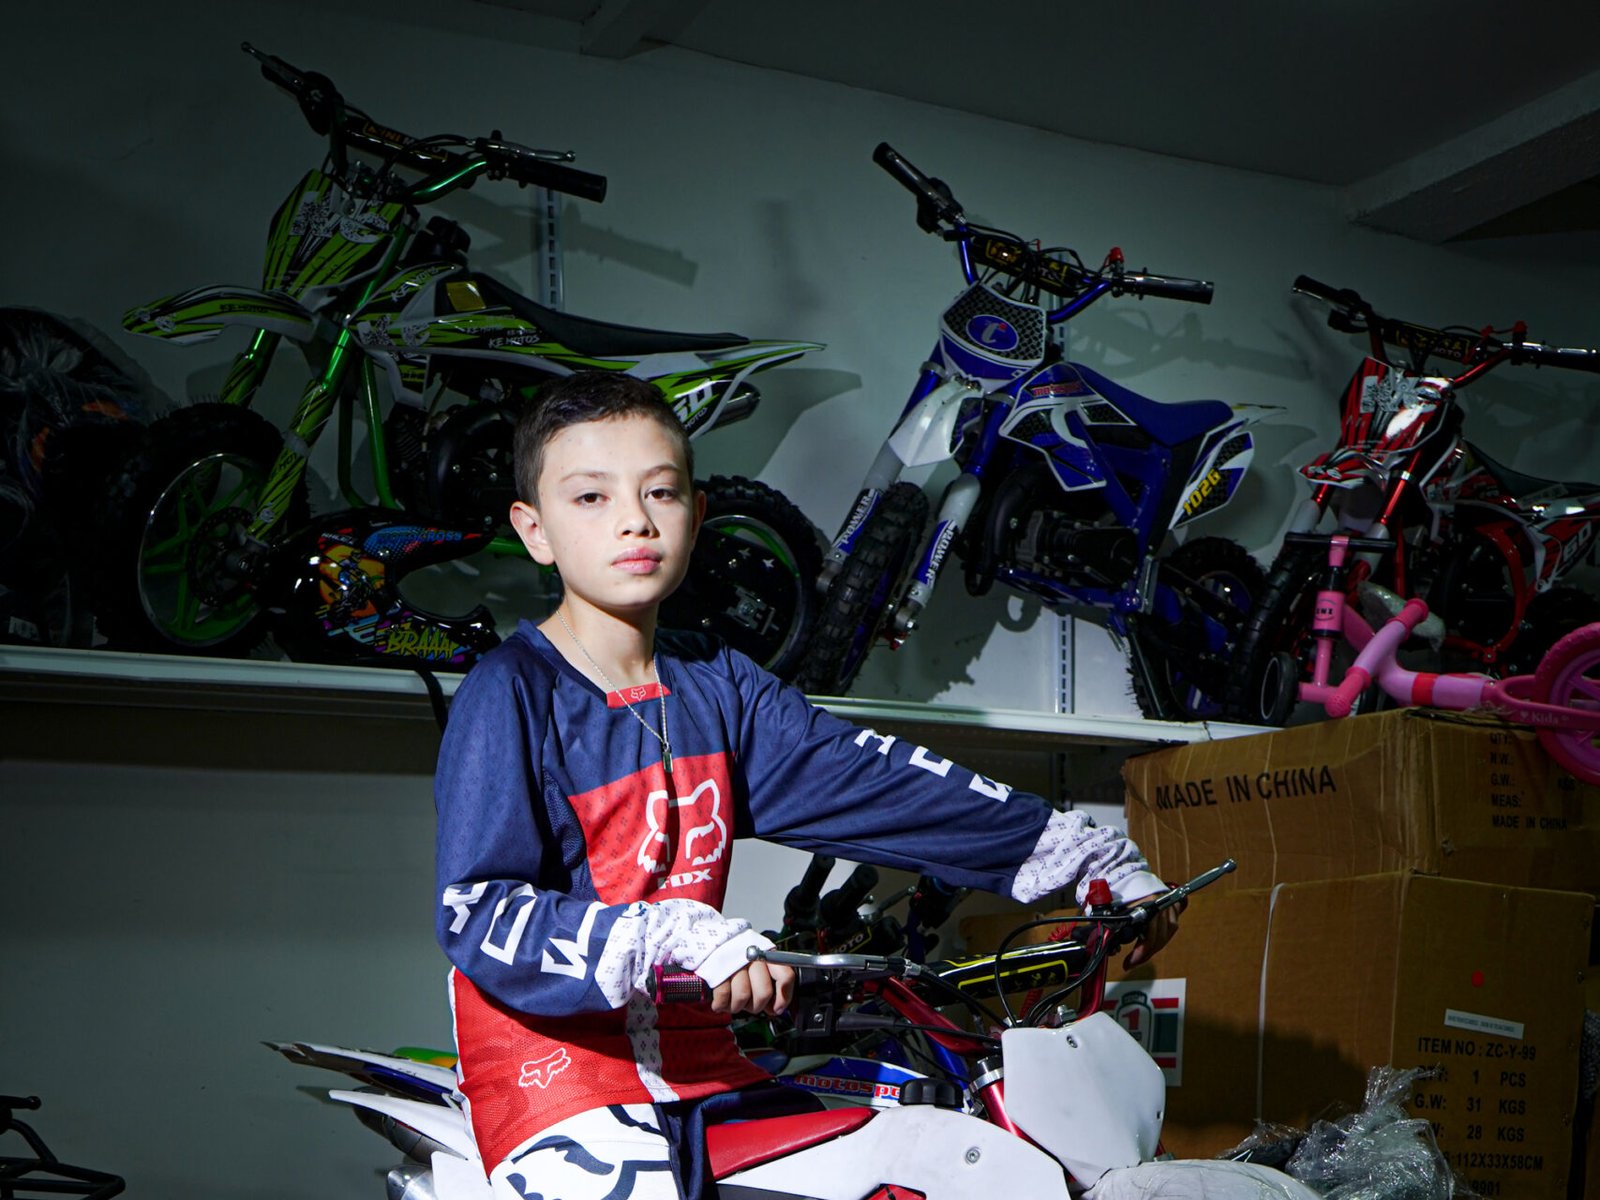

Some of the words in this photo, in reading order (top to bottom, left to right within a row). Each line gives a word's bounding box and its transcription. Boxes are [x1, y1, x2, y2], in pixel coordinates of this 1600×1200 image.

[840, 494, 872, 546] POWER
[925, 527, 956, 580] POWER
[1156, 778, 1217, 811] MADE
[1226, 774, 1251, 803] IN
[1256, 765, 1337, 800] CHINA
[1492, 815, 1520, 829] MADE
[1526, 816, 1536, 829] IN
[1540, 817, 1568, 831] CHINA
[656, 865, 714, 891] FOX
[1417, 1037, 1452, 1055] ITEM
[1486, 1042, 1537, 1061] ZC-Y-99
[1472, 1069, 1480, 1085] 1
[1500, 1071, 1527, 1088] PCS
[1466, 1097, 1482, 1113] 31
[1499, 1098, 1527, 1116] KGS
[1466, 1124, 1483, 1141] 28
[1497, 1126, 1525, 1142] KGS
